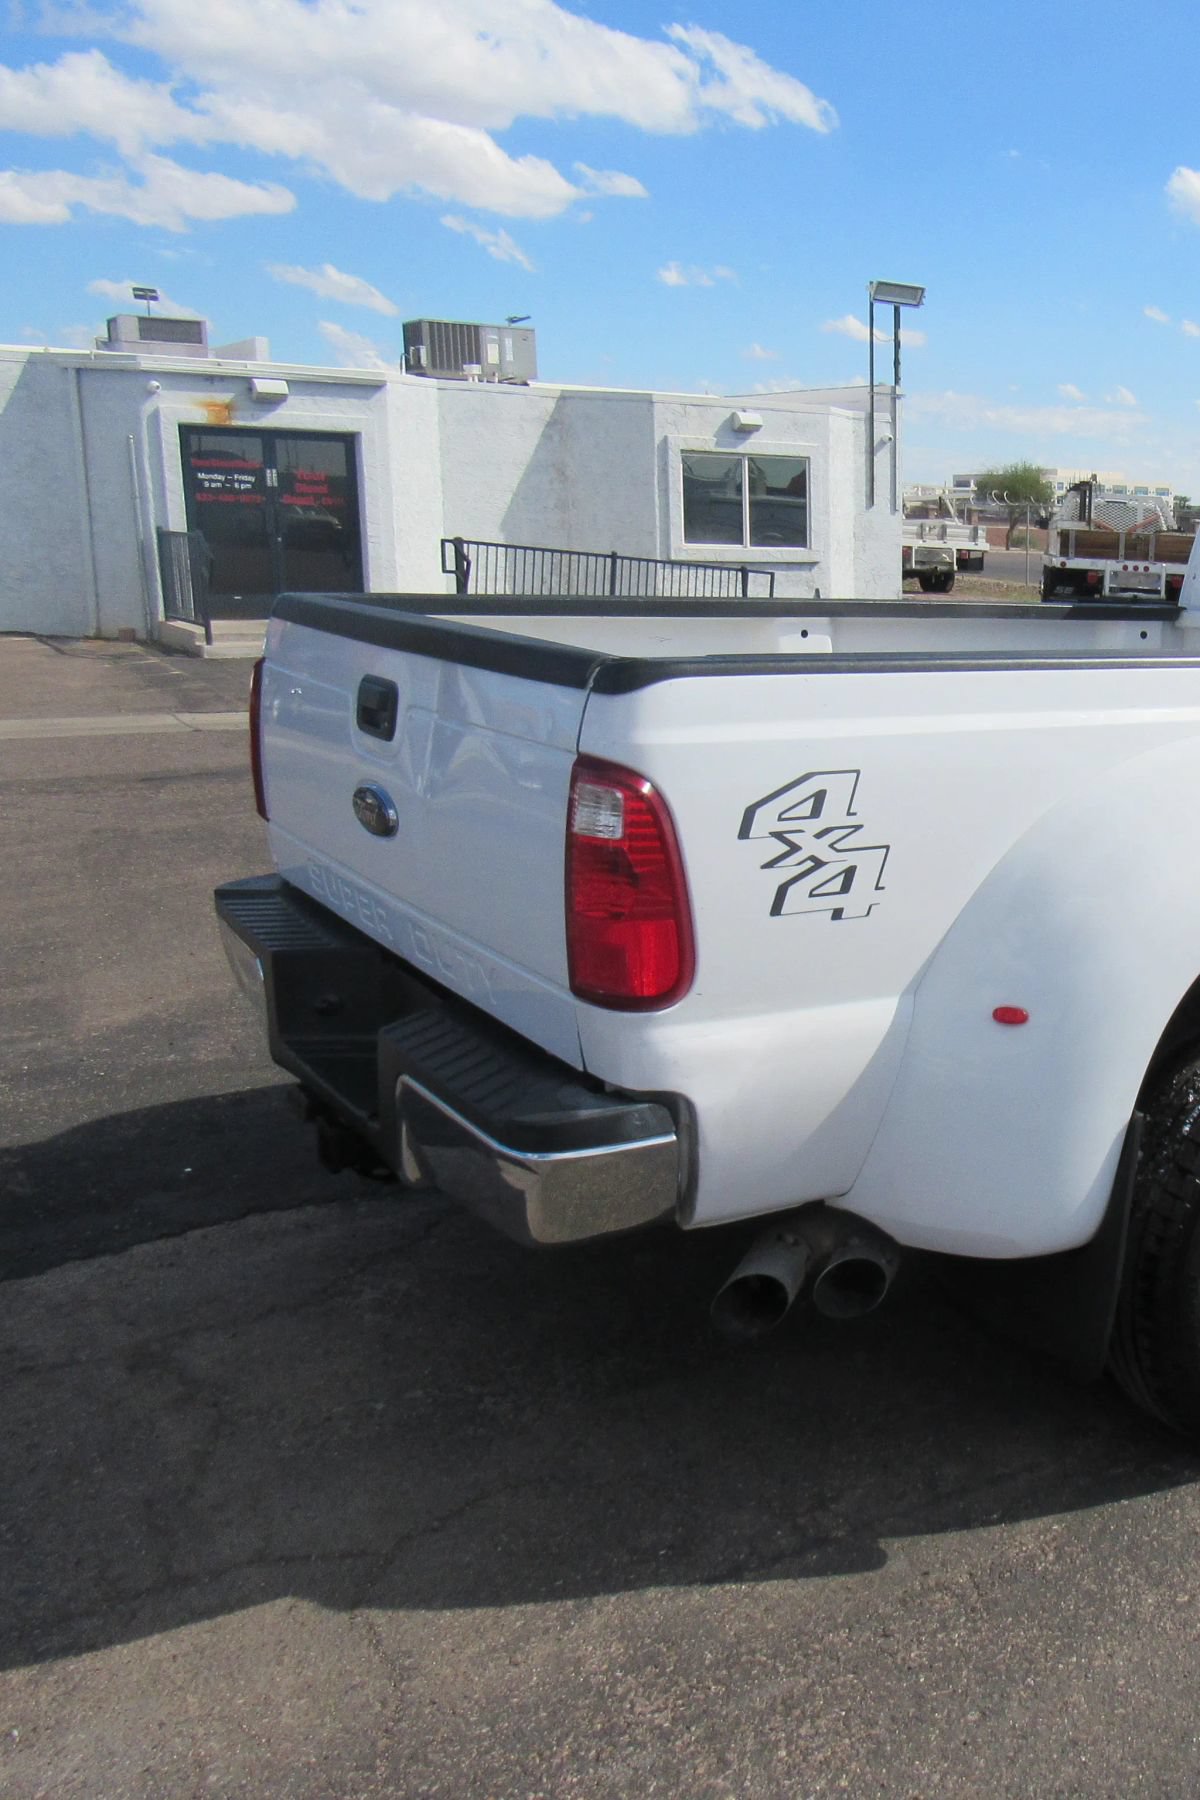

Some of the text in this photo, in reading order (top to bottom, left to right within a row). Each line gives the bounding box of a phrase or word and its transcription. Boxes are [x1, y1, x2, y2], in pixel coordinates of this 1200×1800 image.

[197, 472, 226, 481] Monday
[234, 473, 256, 483] Friday
[307, 864, 394, 941] SUPER
